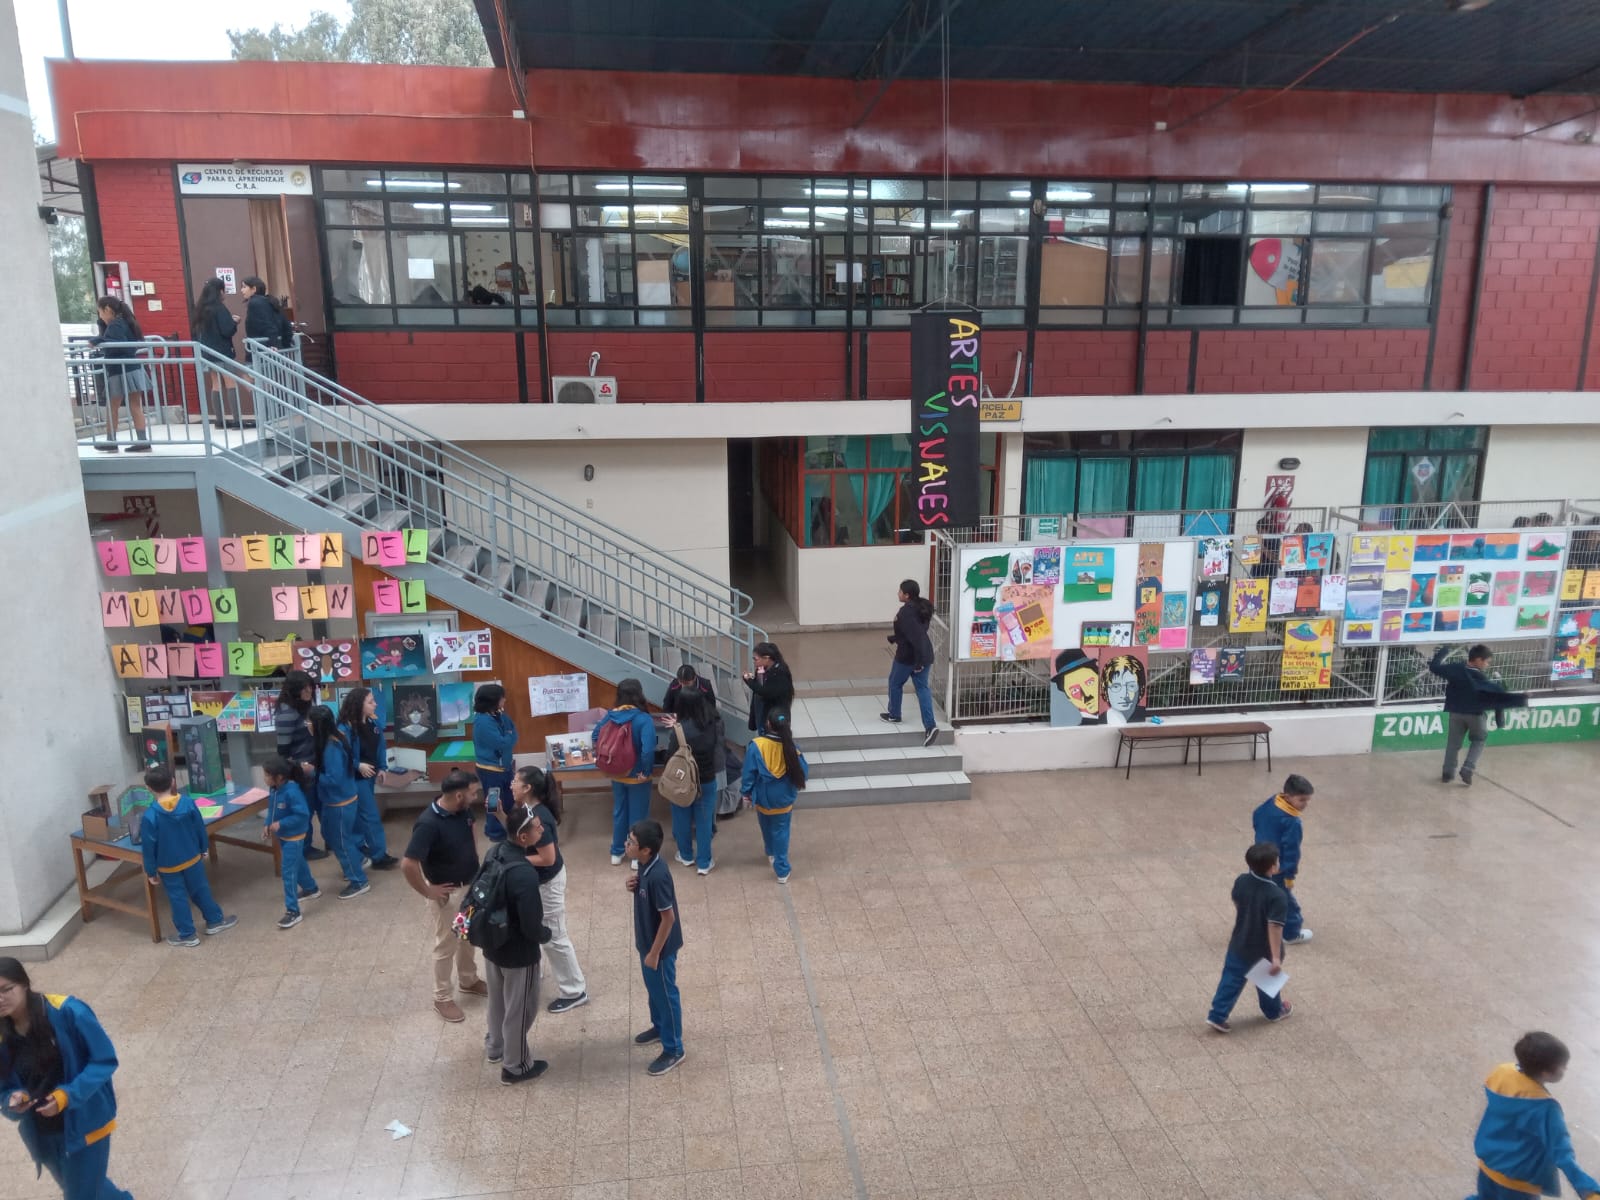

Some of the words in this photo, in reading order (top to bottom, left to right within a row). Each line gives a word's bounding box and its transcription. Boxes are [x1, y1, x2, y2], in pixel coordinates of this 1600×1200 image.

[948, 317, 980, 408] ARTES
[981, 403, 1014, 411] RCELA
[984, 411, 1006, 419] PAZ
[105, 541, 200, 572] ¿QUE
[222, 535, 340, 566] SERIA
[367, 529, 421, 559] DEL
[106, 591, 232, 623] MUNDO
[275, 586, 348, 614] SIN
[377, 582, 421, 607] EL
[1318, 620, 1333, 685] ATE
[1381, 714, 1444, 737] ZONA
[1486, 707, 1581, 731] GURIDAD
